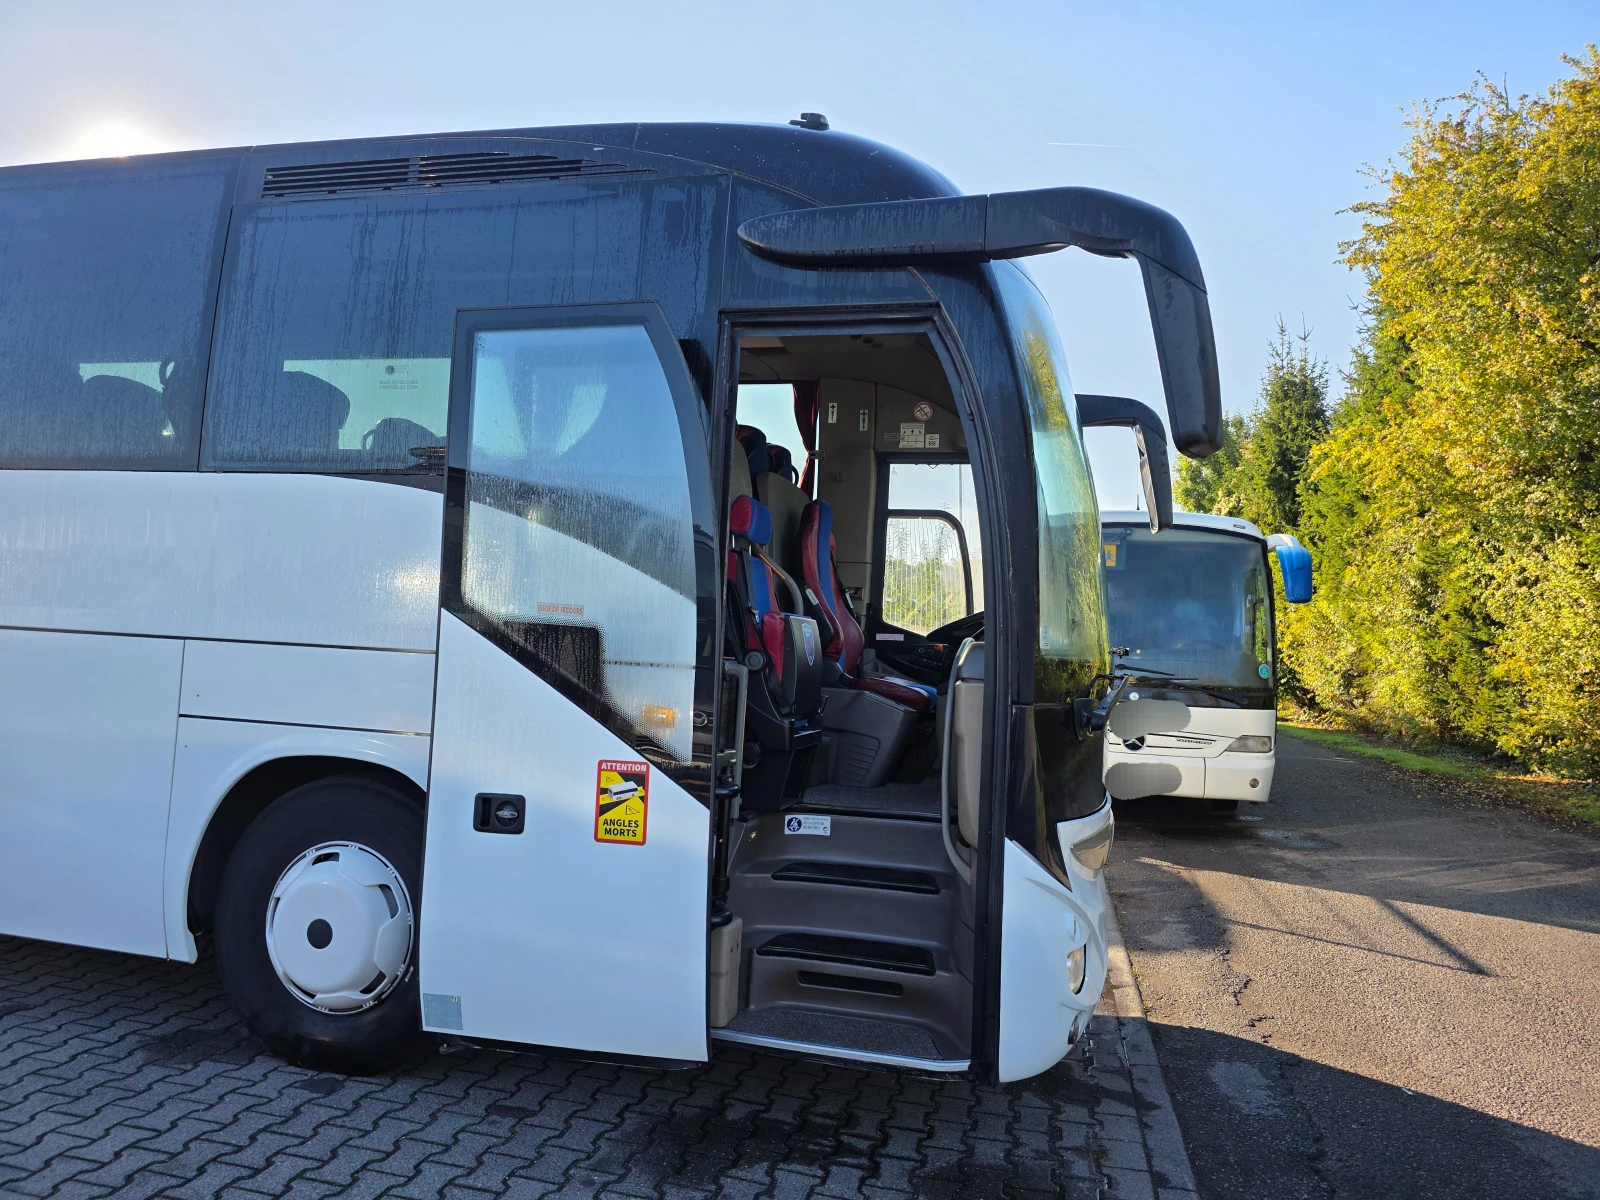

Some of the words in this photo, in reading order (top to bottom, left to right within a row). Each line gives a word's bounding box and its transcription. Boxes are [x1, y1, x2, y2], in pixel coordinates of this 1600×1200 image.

[552, 605, 559, 613] DE
[560, 606, 583, 615] SECOURS
[601, 762, 647, 772] ATTENTION
[602, 818, 639, 828] ANGLES
[604, 828, 637, 838] MORTS
